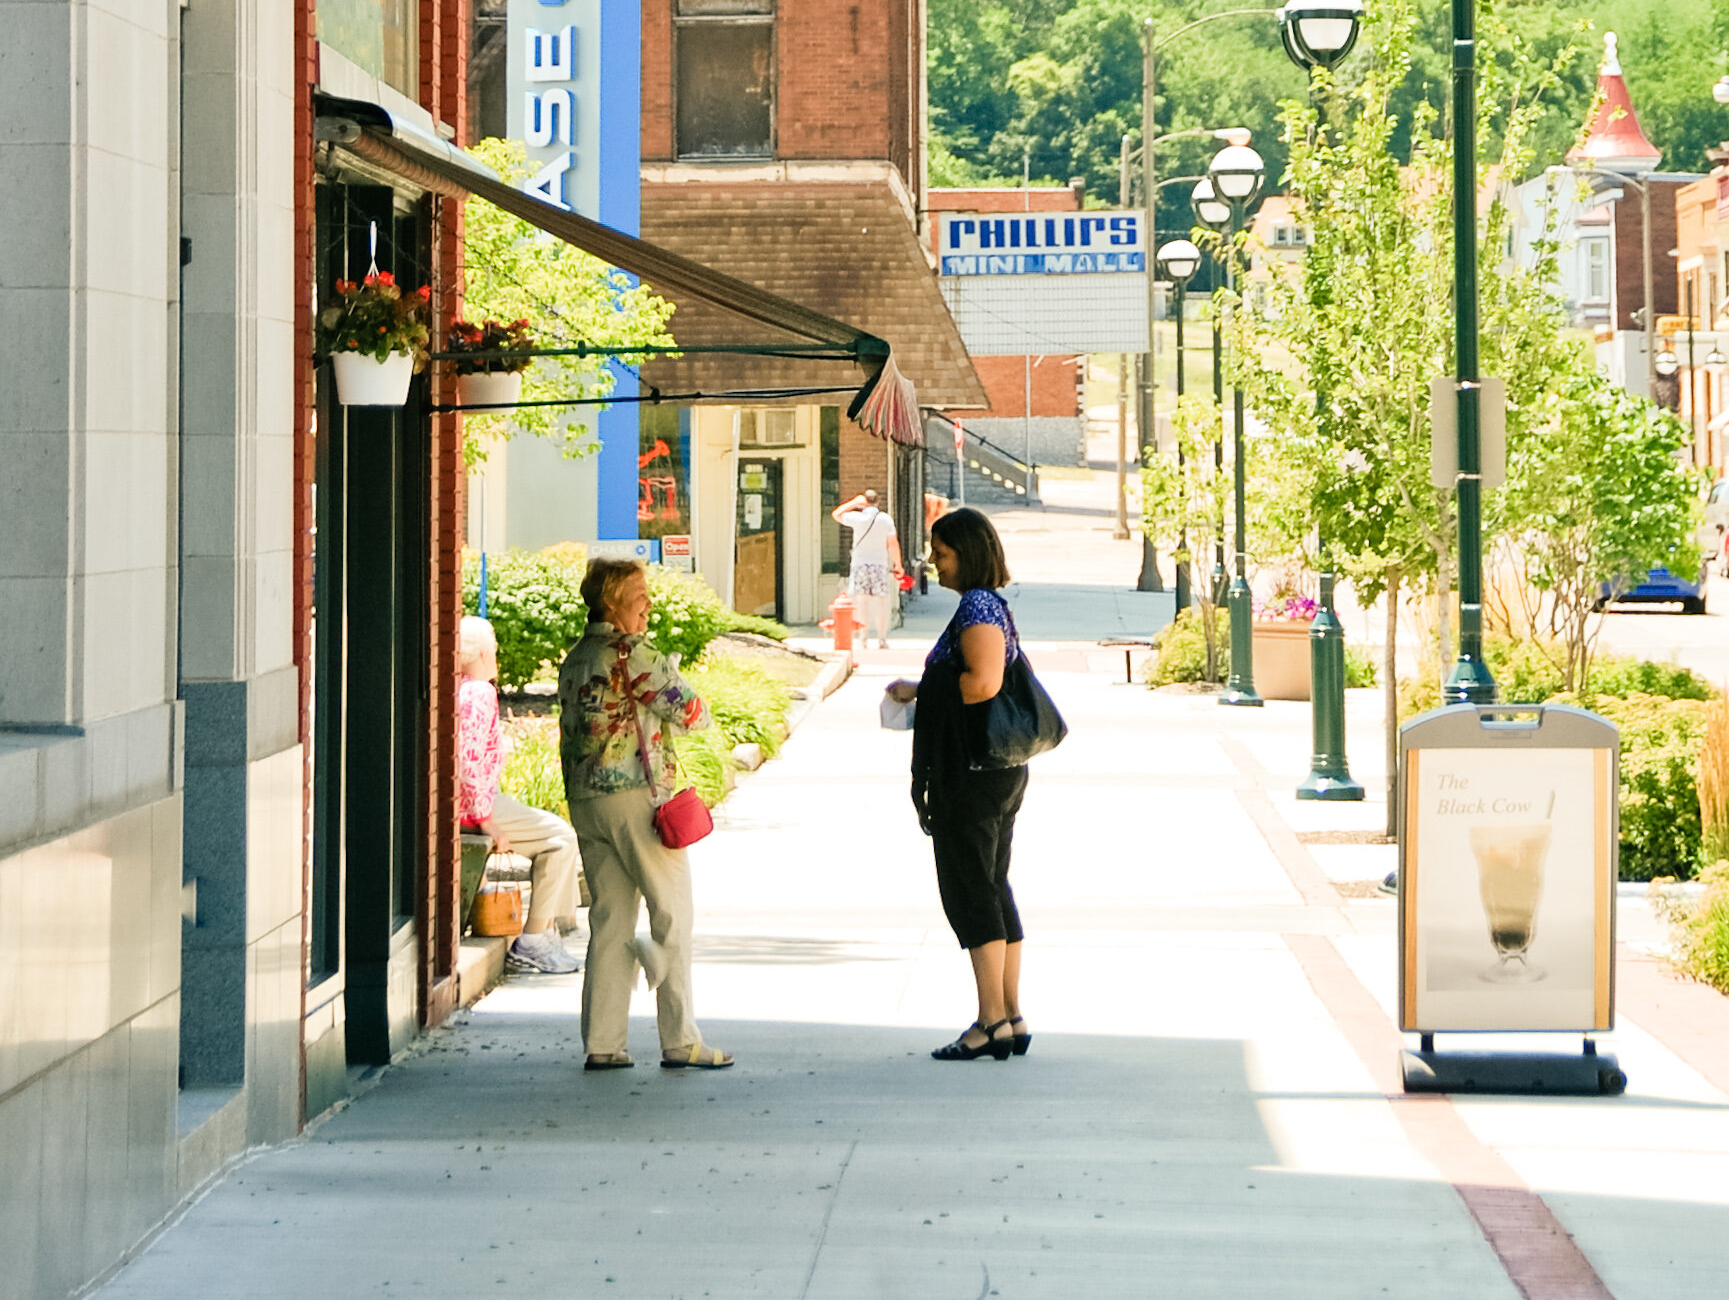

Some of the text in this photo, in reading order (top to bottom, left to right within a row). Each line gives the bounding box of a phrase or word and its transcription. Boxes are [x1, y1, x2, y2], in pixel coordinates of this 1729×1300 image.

[524, 25, 575, 212] ASE
[949, 216, 1137, 249] PHILLIPS
[948, 253, 1139, 275] MINI MALL
[1437, 773, 1469, 790] The
[1437, 796, 1532, 815] Black Cow
